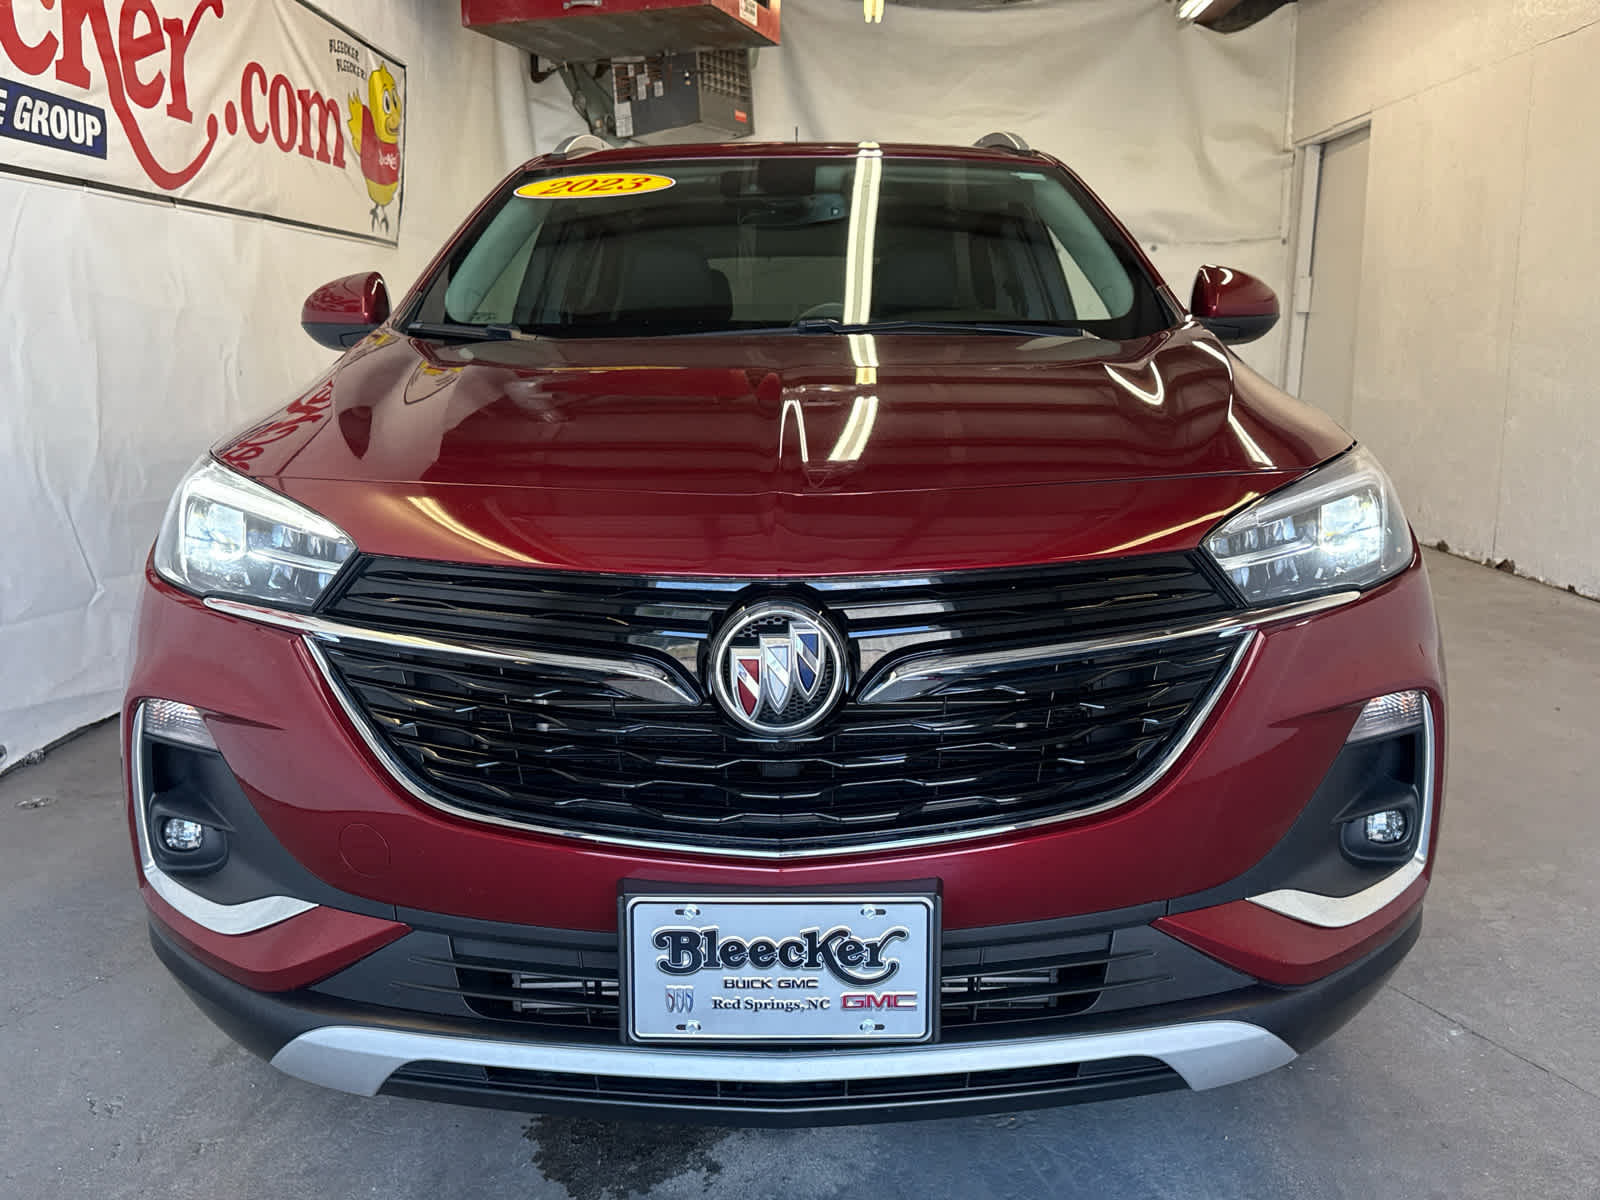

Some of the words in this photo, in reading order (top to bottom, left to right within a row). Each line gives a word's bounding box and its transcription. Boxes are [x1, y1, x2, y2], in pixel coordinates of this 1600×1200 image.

[13, 95, 102, 147] GROUP
[538, 177, 652, 195] 2023
[723, 977, 772, 990] BUICK
[777, 977, 820, 990] GMC
[711, 997, 741, 1011] Red
[744, 997, 805, 1013] Springs,
[807, 997, 831, 1011] NC
[841, 993, 919, 1011] GMC
